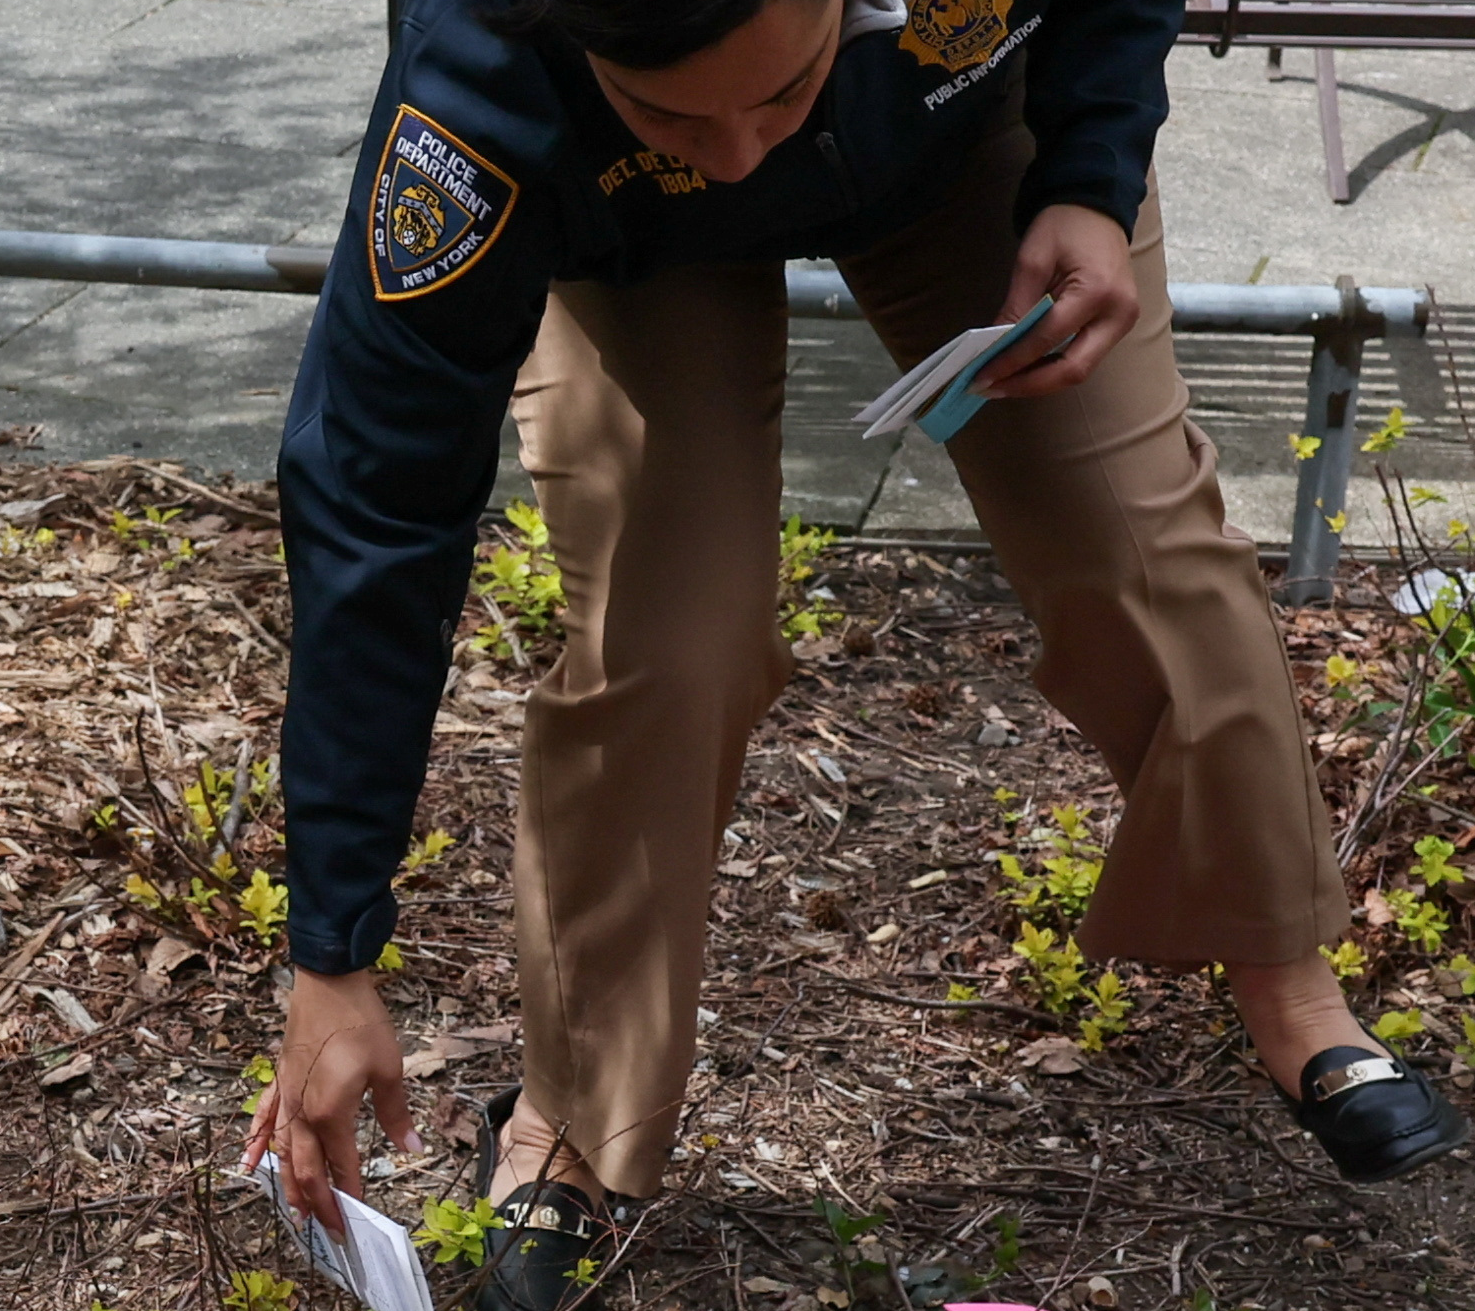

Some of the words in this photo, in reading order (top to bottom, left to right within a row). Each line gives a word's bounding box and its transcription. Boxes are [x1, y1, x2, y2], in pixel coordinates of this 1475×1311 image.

[923, 73, 970, 111] PUBLIC
[968, 14, 1043, 84] INFORMATION
[394, 136, 492, 221] DEPARTMENT
[418, 131, 478, 186] POLICE
[599, 157, 637, 196] DET.
[374, 173, 391, 222] CITY
[374, 229, 387, 257] OF
[401, 264, 437, 288] NEW
[437, 231, 484, 271] YORK
